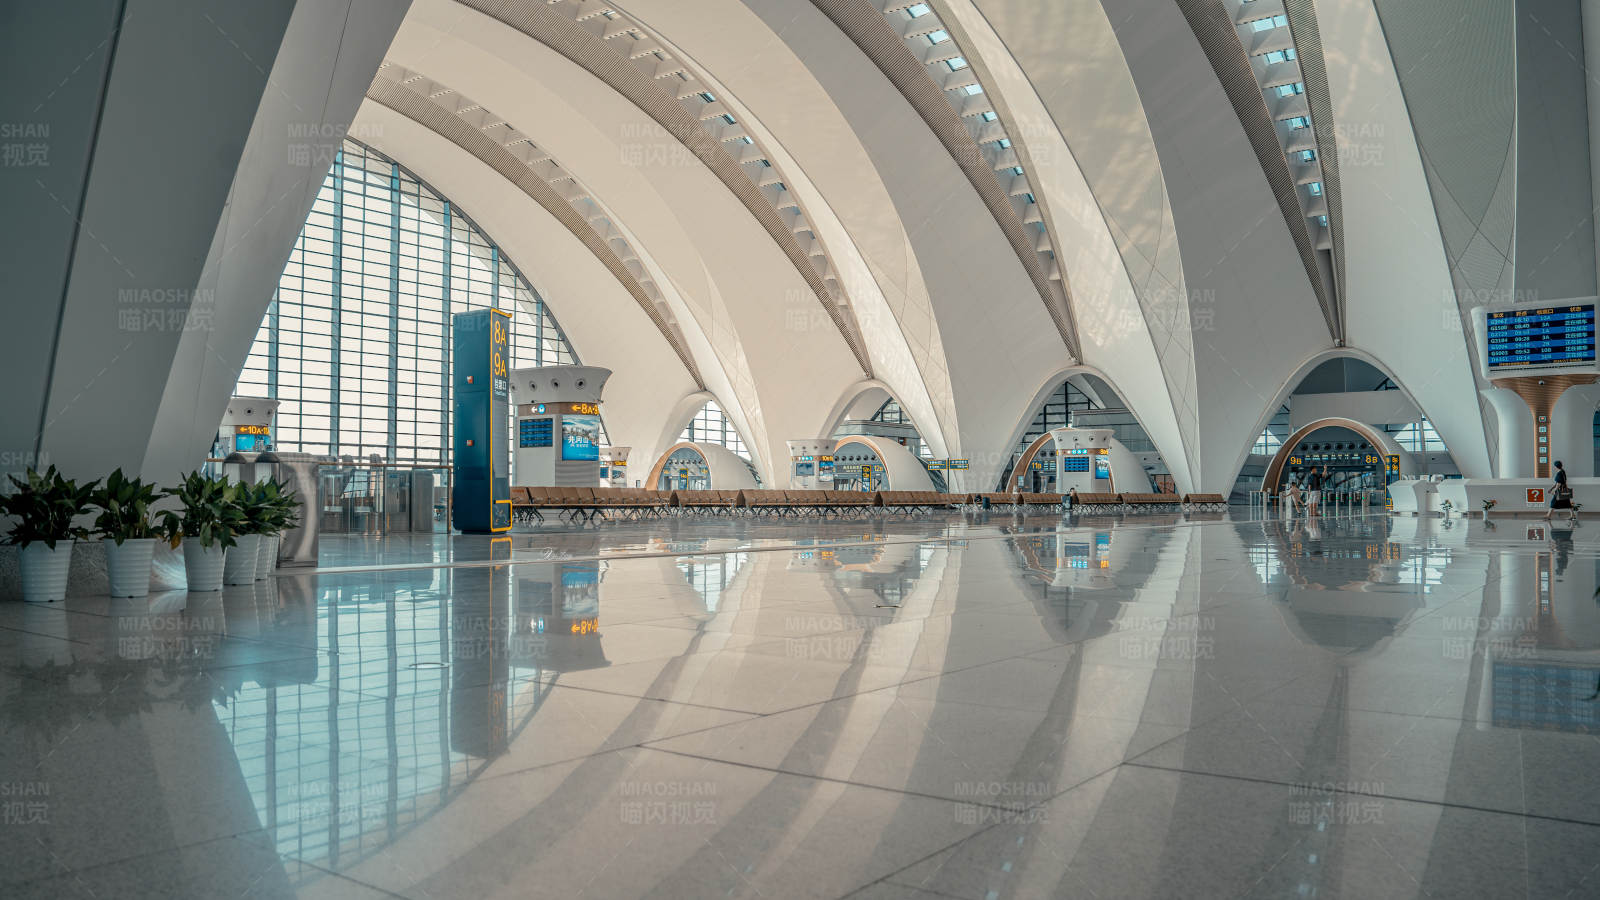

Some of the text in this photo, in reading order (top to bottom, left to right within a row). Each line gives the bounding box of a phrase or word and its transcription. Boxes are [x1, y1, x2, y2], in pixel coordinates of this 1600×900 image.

[494, 320, 507, 347] 8A
[494, 352, 507, 378] 9A
[1365, 455, 1378, 463] 8B
